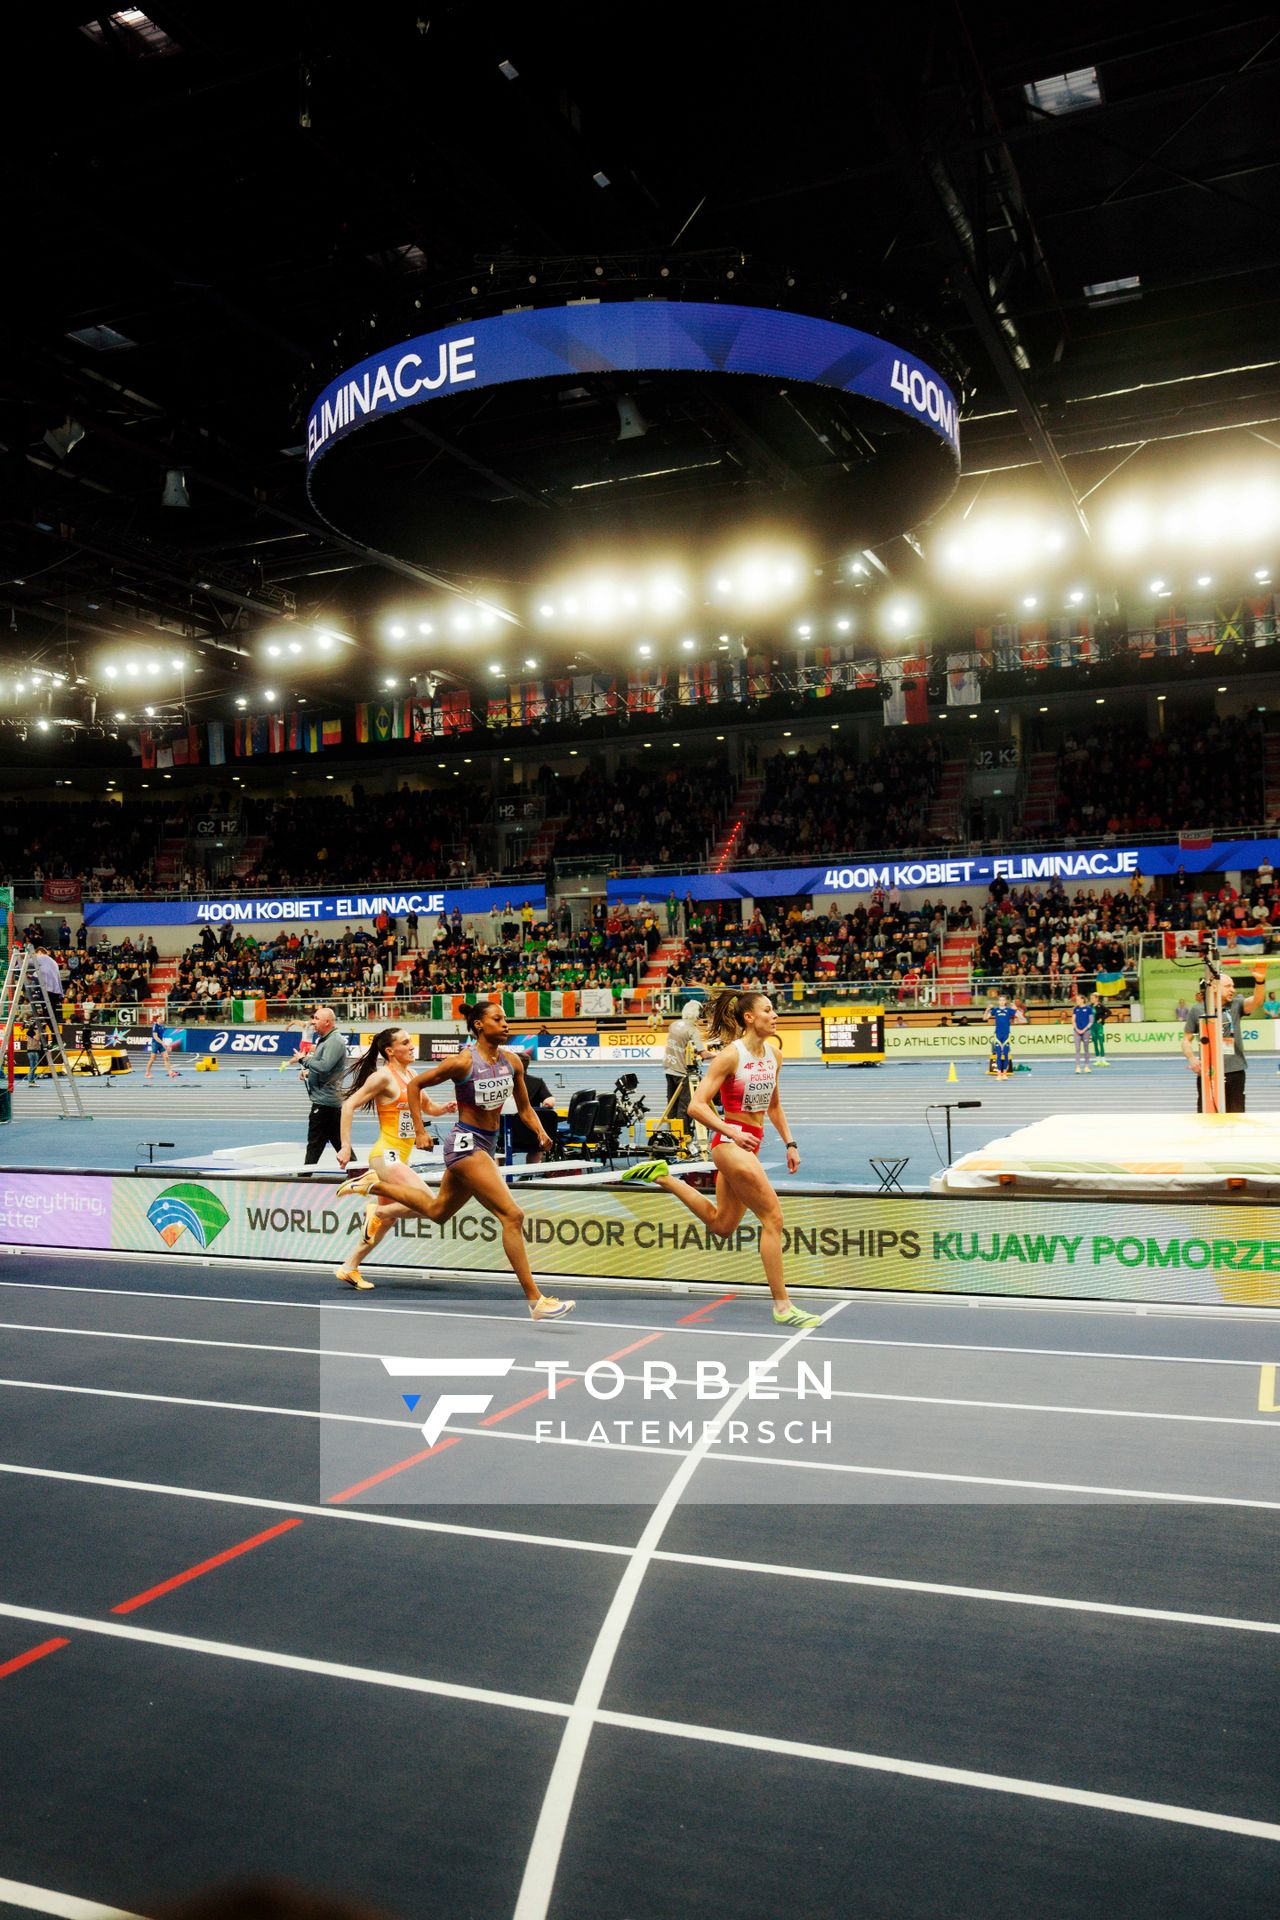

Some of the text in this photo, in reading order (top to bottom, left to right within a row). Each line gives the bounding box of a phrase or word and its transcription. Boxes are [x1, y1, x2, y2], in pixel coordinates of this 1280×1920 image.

[308, 336, 476, 462] ELIMINACJE
[890, 359, 953, 438] 400M
[197, 820, 238, 833] G2 H2
[824, 867, 891, 889] 400M
[893, 861, 975, 885] KOBIET
[993, 851, 1139, 879] ELIMINACJE
[197, 902, 256, 921] 400M
[256, 900, 323, 920] KOBIET
[336, 894, 445, 916] ELIMINACJE
[118, 1009, 137, 1022] G1
[560, 1036, 587, 1046] asics
[608, 1035, 656, 1046] SEIKO
[903, 1036, 965, 1047] ATHLETICS
[968, 1035, 1015, 1046] INDOR
[1125, 1032, 1175, 1043] KUJAWY
[1242, 1030, 1258, 1040] 26
[231, 1034, 280, 1052] asics
[544, 1049, 594, 1059] SONY
[621, 1048, 651, 1058] TDK
[750, 1073, 774, 1081] POLSKA
[479, 1078, 510, 1090] SONY
[749, 1082, 774, 1091] SONY
[482, 1088, 509, 1102] LEAR
[460, 1135, 469, 1149] 5
[389, 1151, 396, 1162] 3
[4, 1190, 106, 1216] Everything,
[247, 1207, 339, 1234] WORLD
[522, 1217, 625, 1247] NDOOR
[932, 1231, 1084, 1264] KUJAWY
[1092, 1235, 1280, 1272] POMORZE
